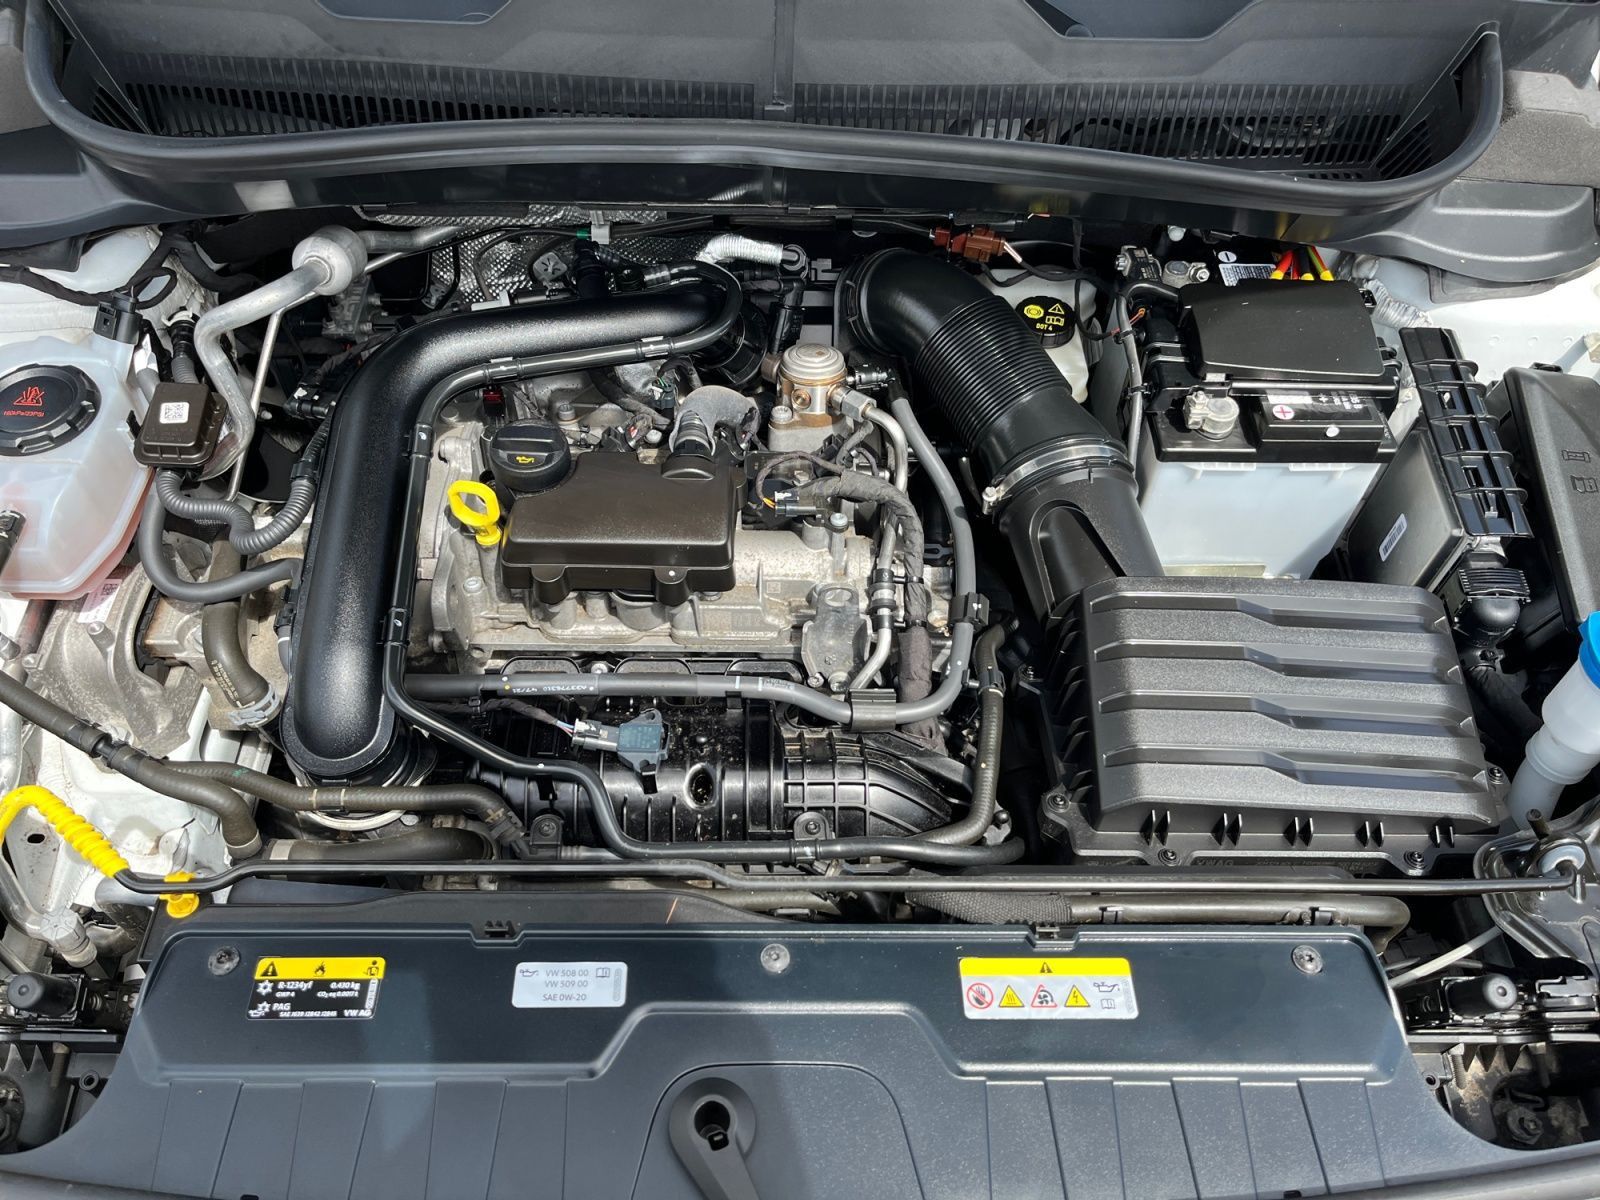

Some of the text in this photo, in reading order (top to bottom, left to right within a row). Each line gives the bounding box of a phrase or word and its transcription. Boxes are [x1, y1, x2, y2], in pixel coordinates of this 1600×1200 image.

[278, 981, 314, 991] R-1234yf
[351, 982, 361, 990] kg
[272, 1003, 291, 1011] PAG
